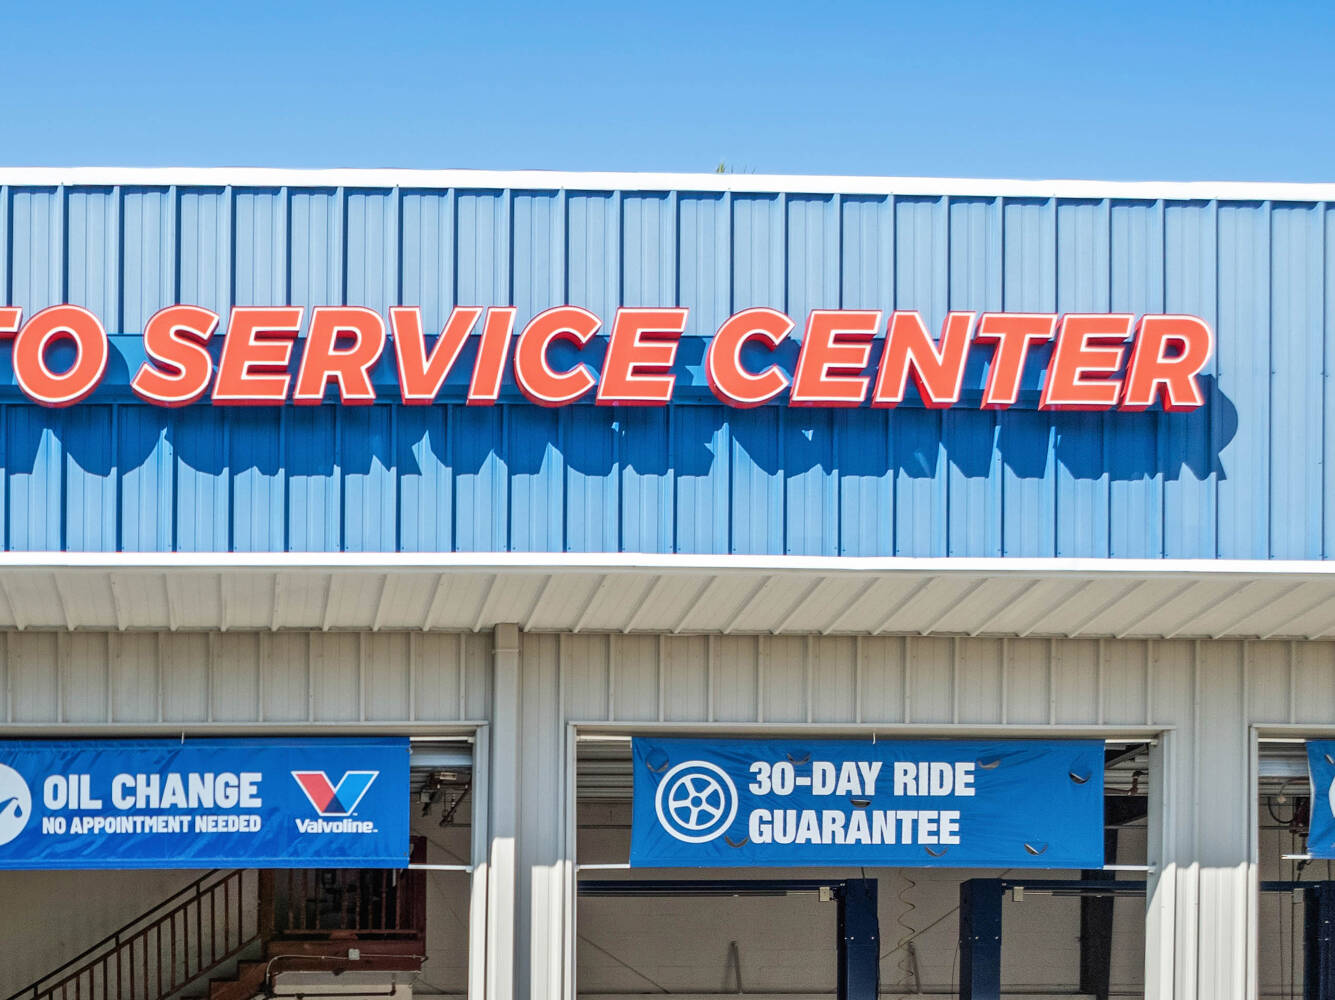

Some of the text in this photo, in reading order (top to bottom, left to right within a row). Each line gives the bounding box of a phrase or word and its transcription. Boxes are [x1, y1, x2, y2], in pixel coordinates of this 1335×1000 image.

[130, 304, 689, 408] SERVICE
[705, 307, 1213, 412] CENTER
[43, 772, 262, 810] OIL CHANGE
[748, 761, 976, 797] 30-DAY RIDE
[42, 815, 262, 835] NO APPOINTMENT NEEDED
[295, 818, 374, 833] Valvoline
[748, 808, 961, 845] GUARANTEE
